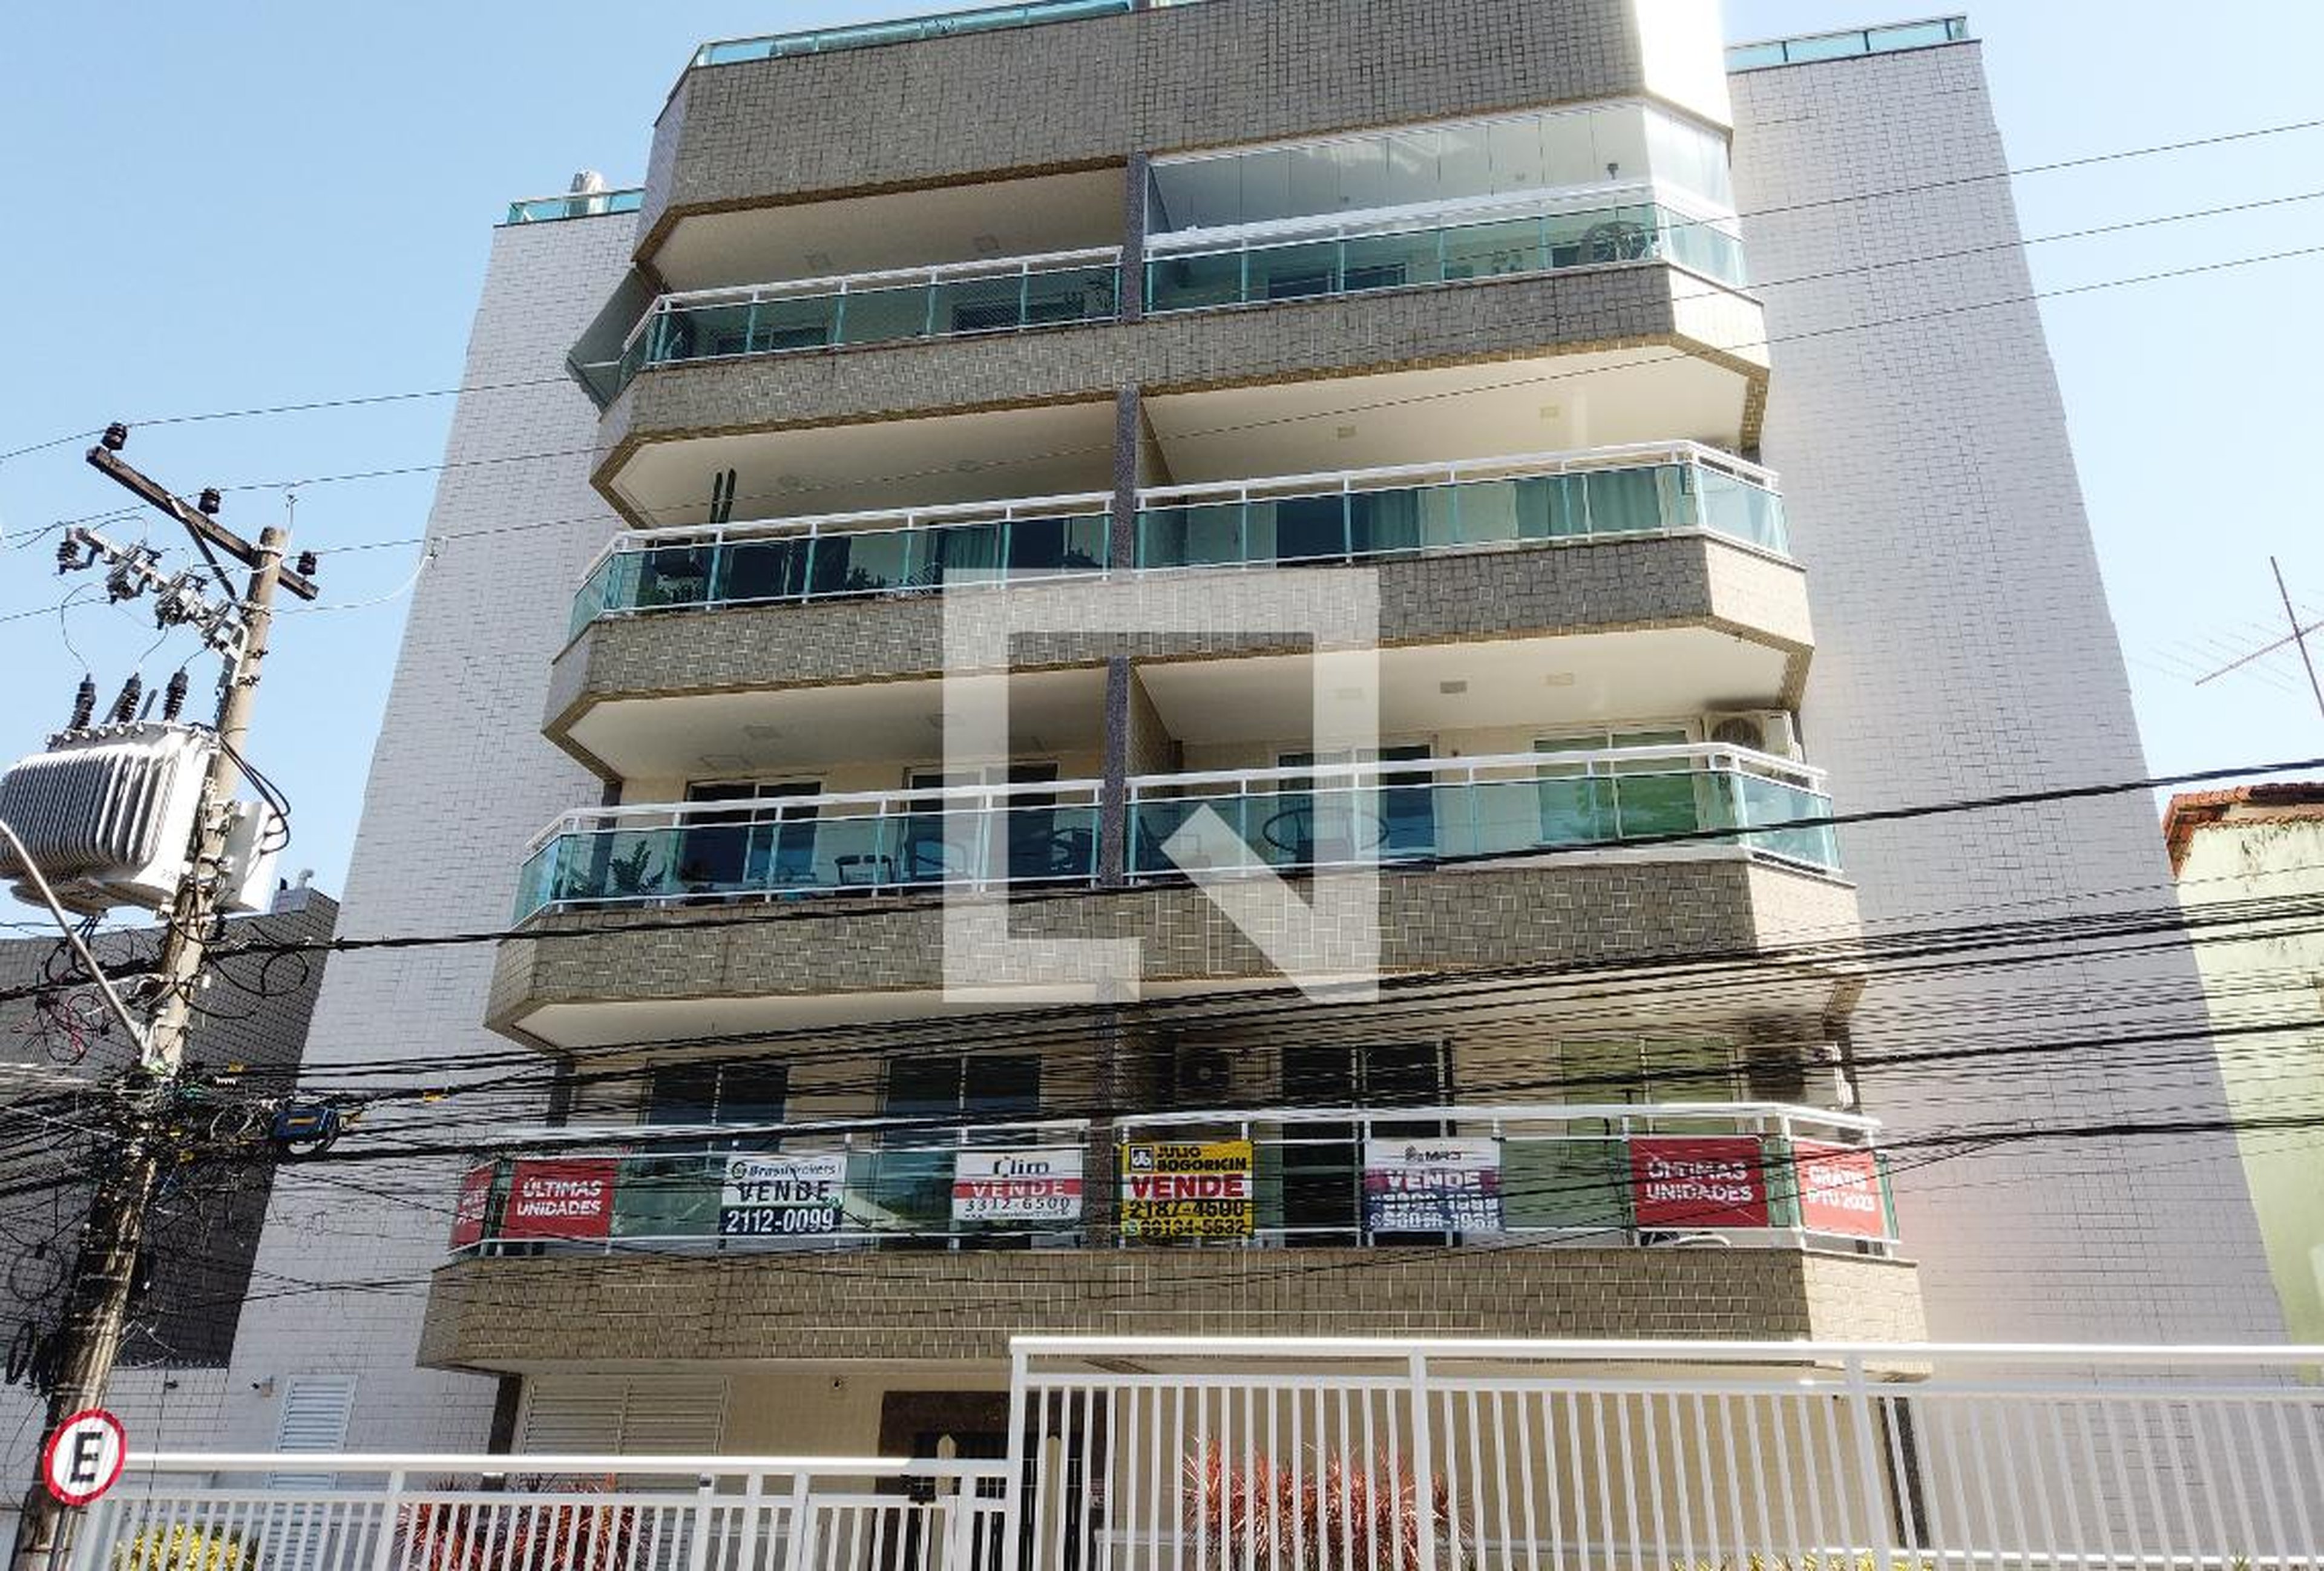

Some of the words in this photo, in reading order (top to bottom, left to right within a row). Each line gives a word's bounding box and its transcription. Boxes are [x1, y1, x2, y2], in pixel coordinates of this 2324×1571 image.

[523, 1176, 603, 1198] ÚLTIMAS
[738, 1181, 832, 1201] VENDE
[971, 1181, 1065, 1197] VENDE
[1131, 1174, 1244, 1199] VENDE
[1387, 1171, 1482, 1191] VENDE
[1646, 1183, 1753, 1201] UNIDADES
[516, 1199, 602, 1216] UNIDADES
[726, 1208, 835, 1233] 2112-0099
[69, 1431, 103, 1483] E
